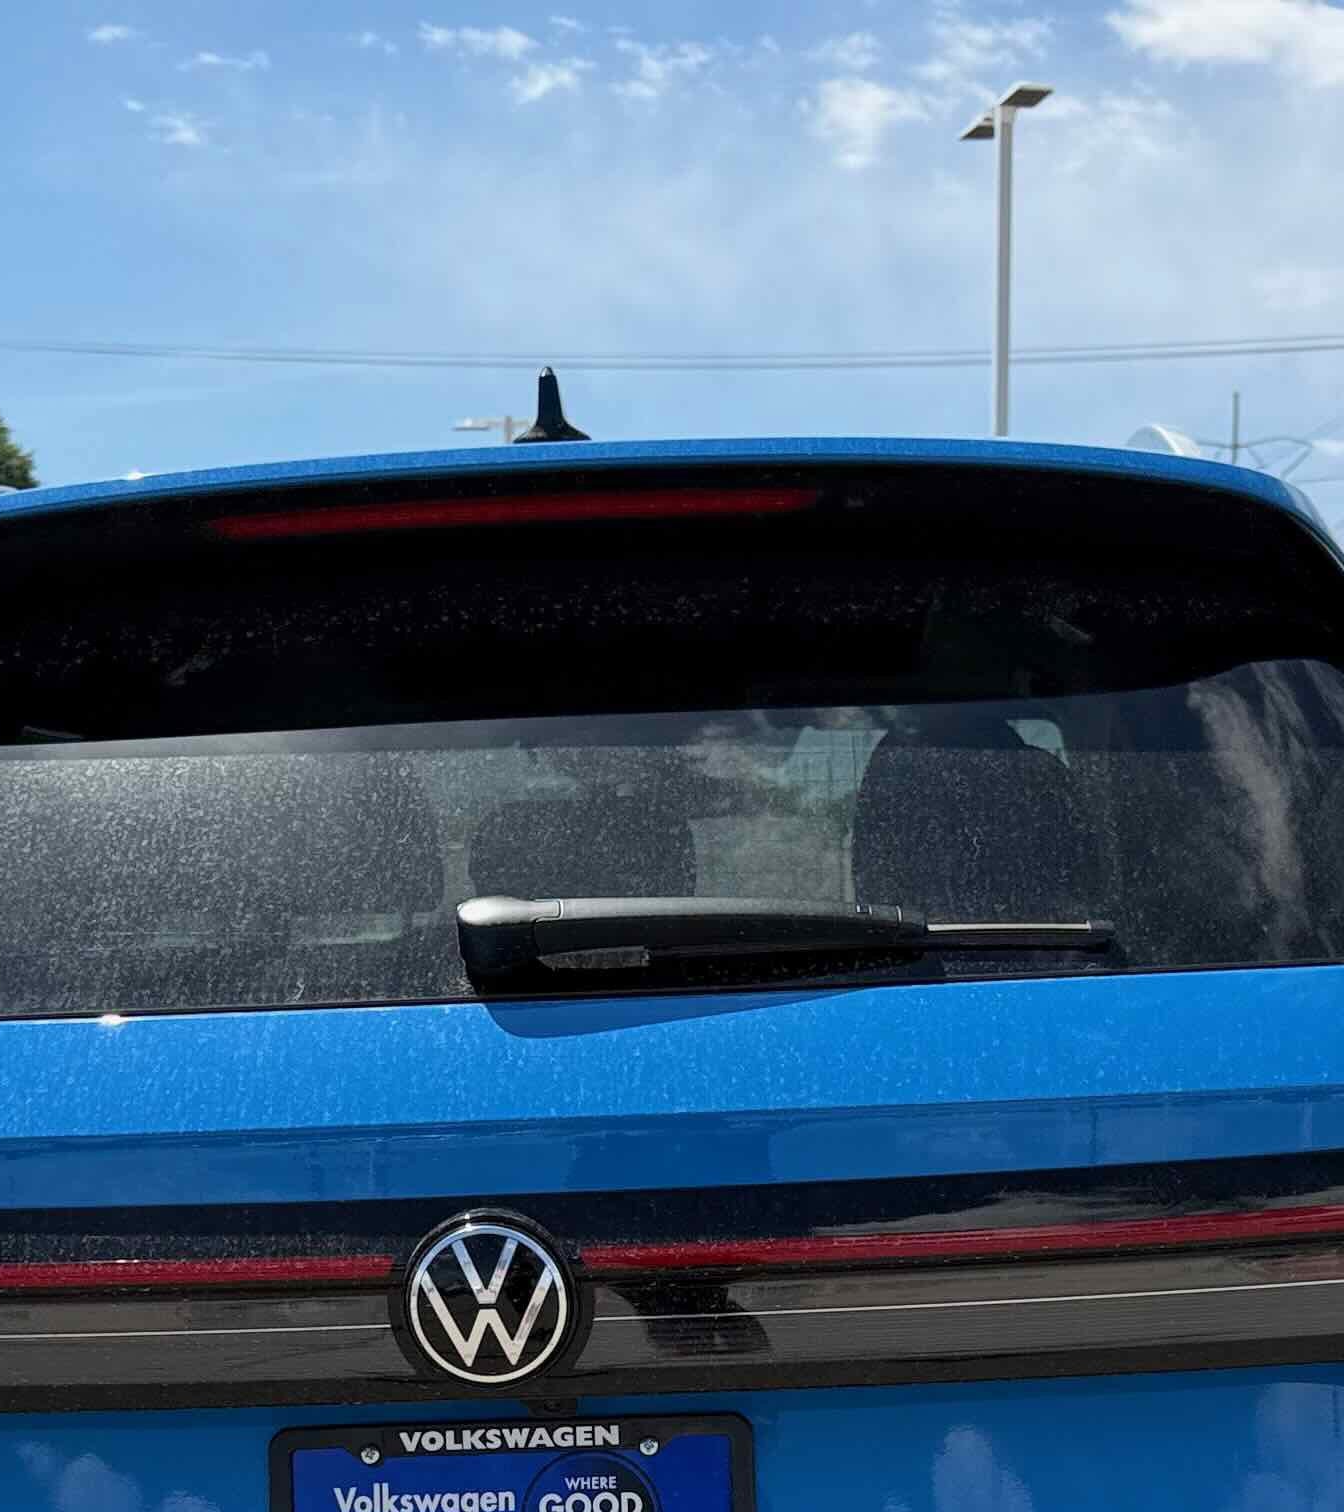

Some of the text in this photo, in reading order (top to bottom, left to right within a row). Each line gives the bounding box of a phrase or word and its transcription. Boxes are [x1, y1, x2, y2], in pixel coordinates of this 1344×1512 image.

[416, 1233, 556, 1369] VW
[399, 1425, 619, 1452] VOLKSWAGEN
[564, 1476, 617, 1490] WHERE
